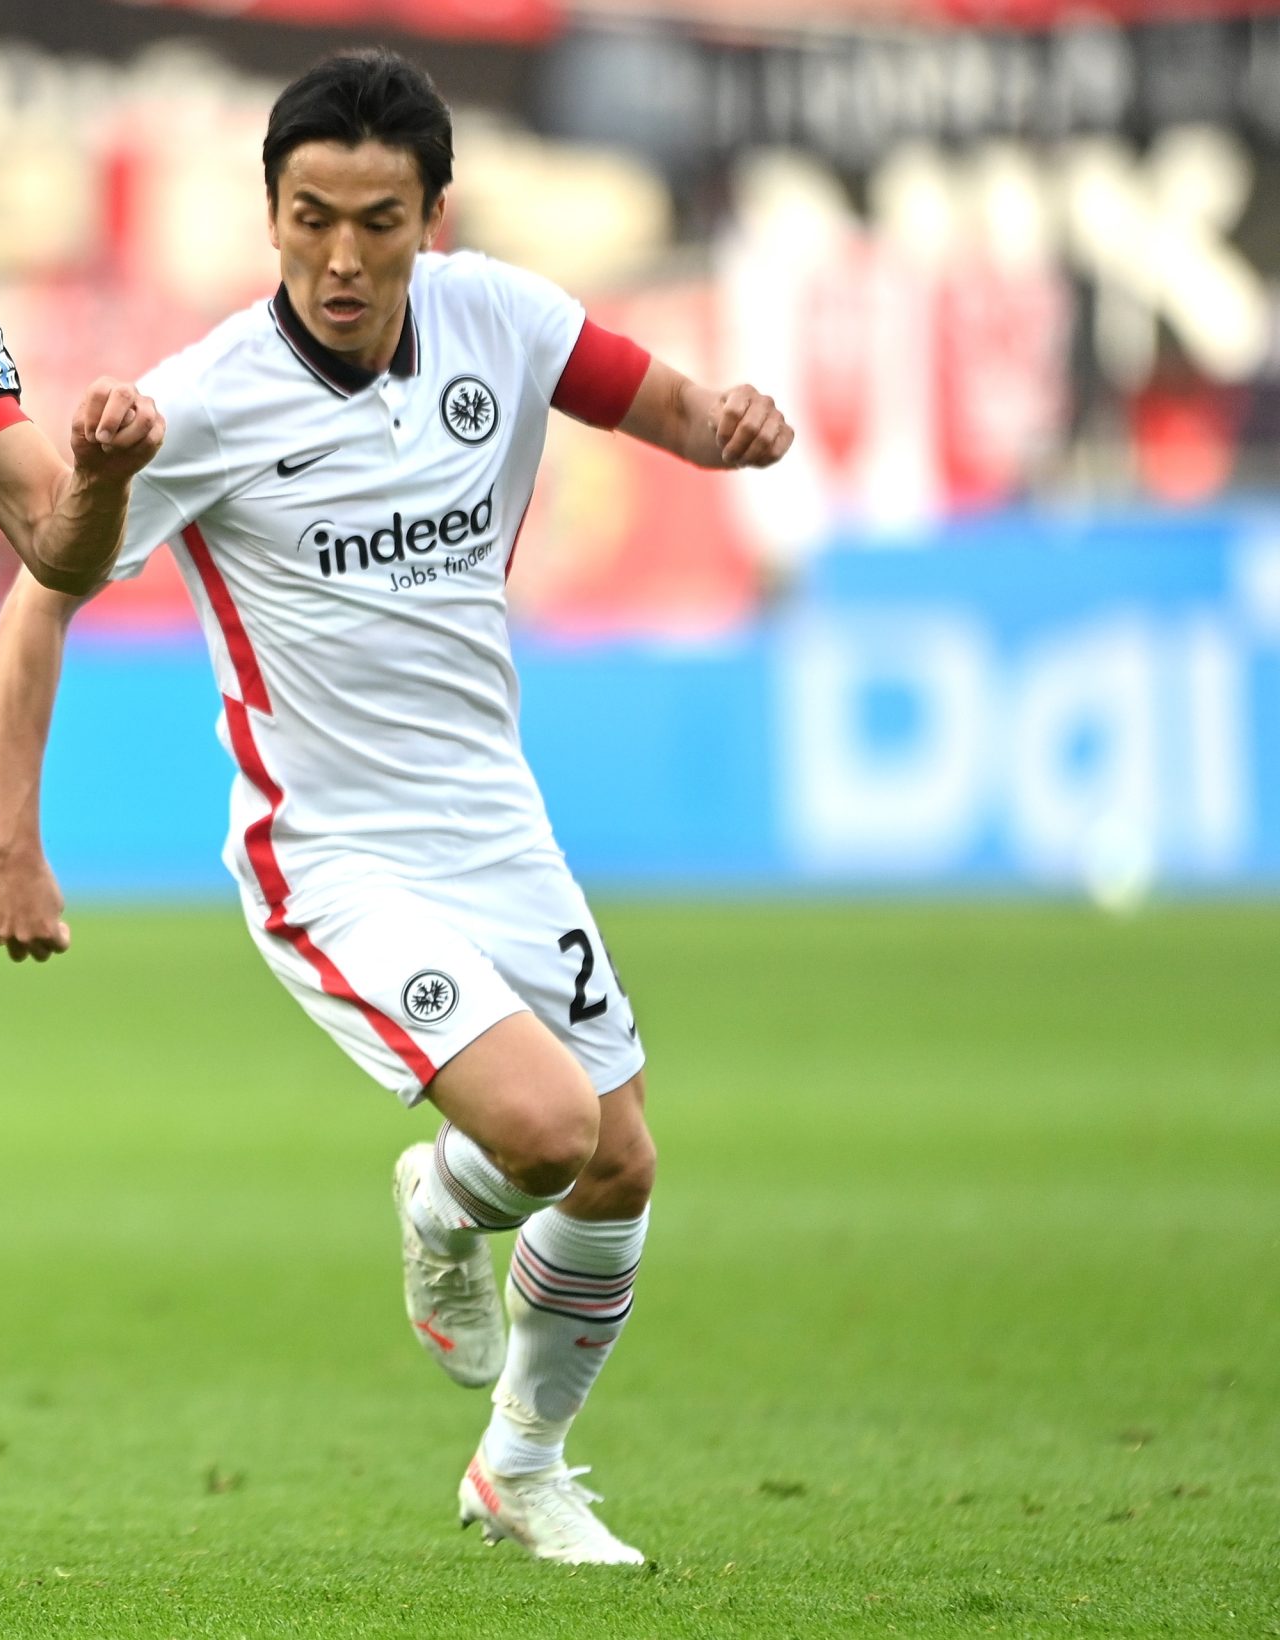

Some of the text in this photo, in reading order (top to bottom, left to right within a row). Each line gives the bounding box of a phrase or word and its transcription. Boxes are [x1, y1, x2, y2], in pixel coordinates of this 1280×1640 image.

[312, 482, 496, 579] indeed
[390, 541, 493, 593] Jobs finden
